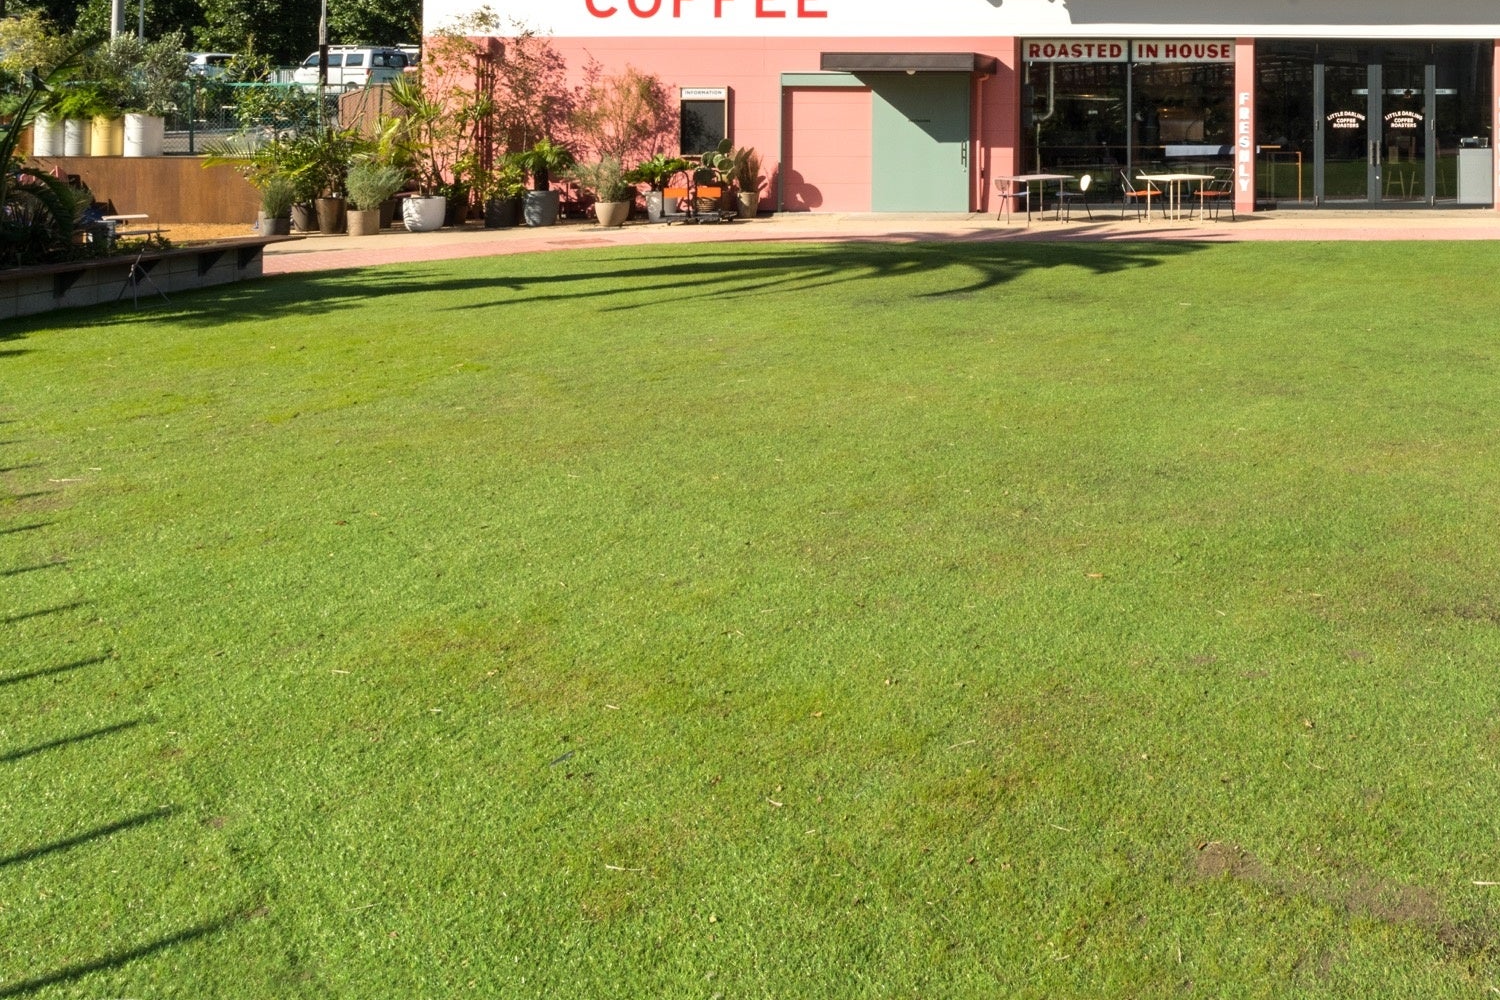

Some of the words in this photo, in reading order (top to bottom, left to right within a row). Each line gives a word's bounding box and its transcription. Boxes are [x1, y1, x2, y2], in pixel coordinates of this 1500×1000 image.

[1029, 43, 1122, 58] ROASTED
[1137, 43, 1158, 58] IN
[1164, 43, 1230, 58] HOUSE
[1326, 111, 1343, 120] LITTLE
[1344, 111, 1365, 120] DARLING
[1385, 111, 1401, 120] LITTLE
[1402, 111, 1423, 120] DARLING
[1238, 92, 1250, 192] FRESHLY
